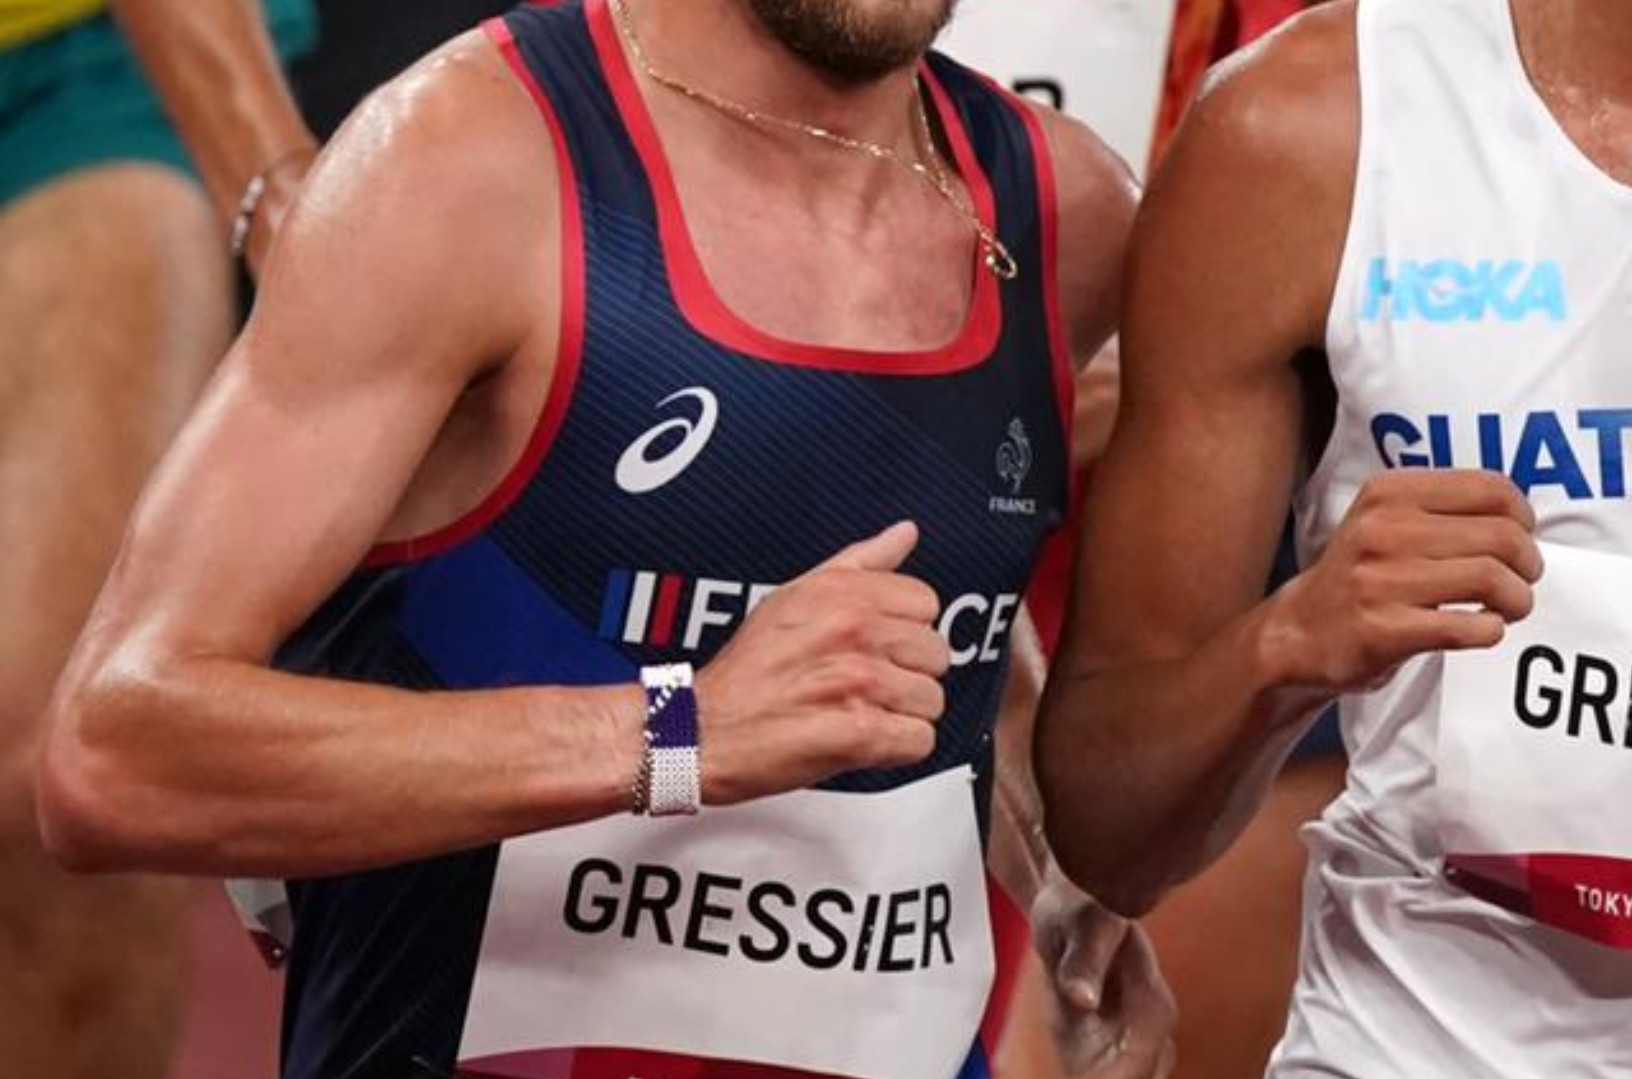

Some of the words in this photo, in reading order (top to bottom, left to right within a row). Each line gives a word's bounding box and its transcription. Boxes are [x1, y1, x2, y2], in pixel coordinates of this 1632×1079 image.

[1363, 258, 1566, 322] HOKA
[988, 496, 1036, 516] FRANCE
[682, 576, 1018, 668] FCE
[563, 858, 955, 973] GRESSIER
